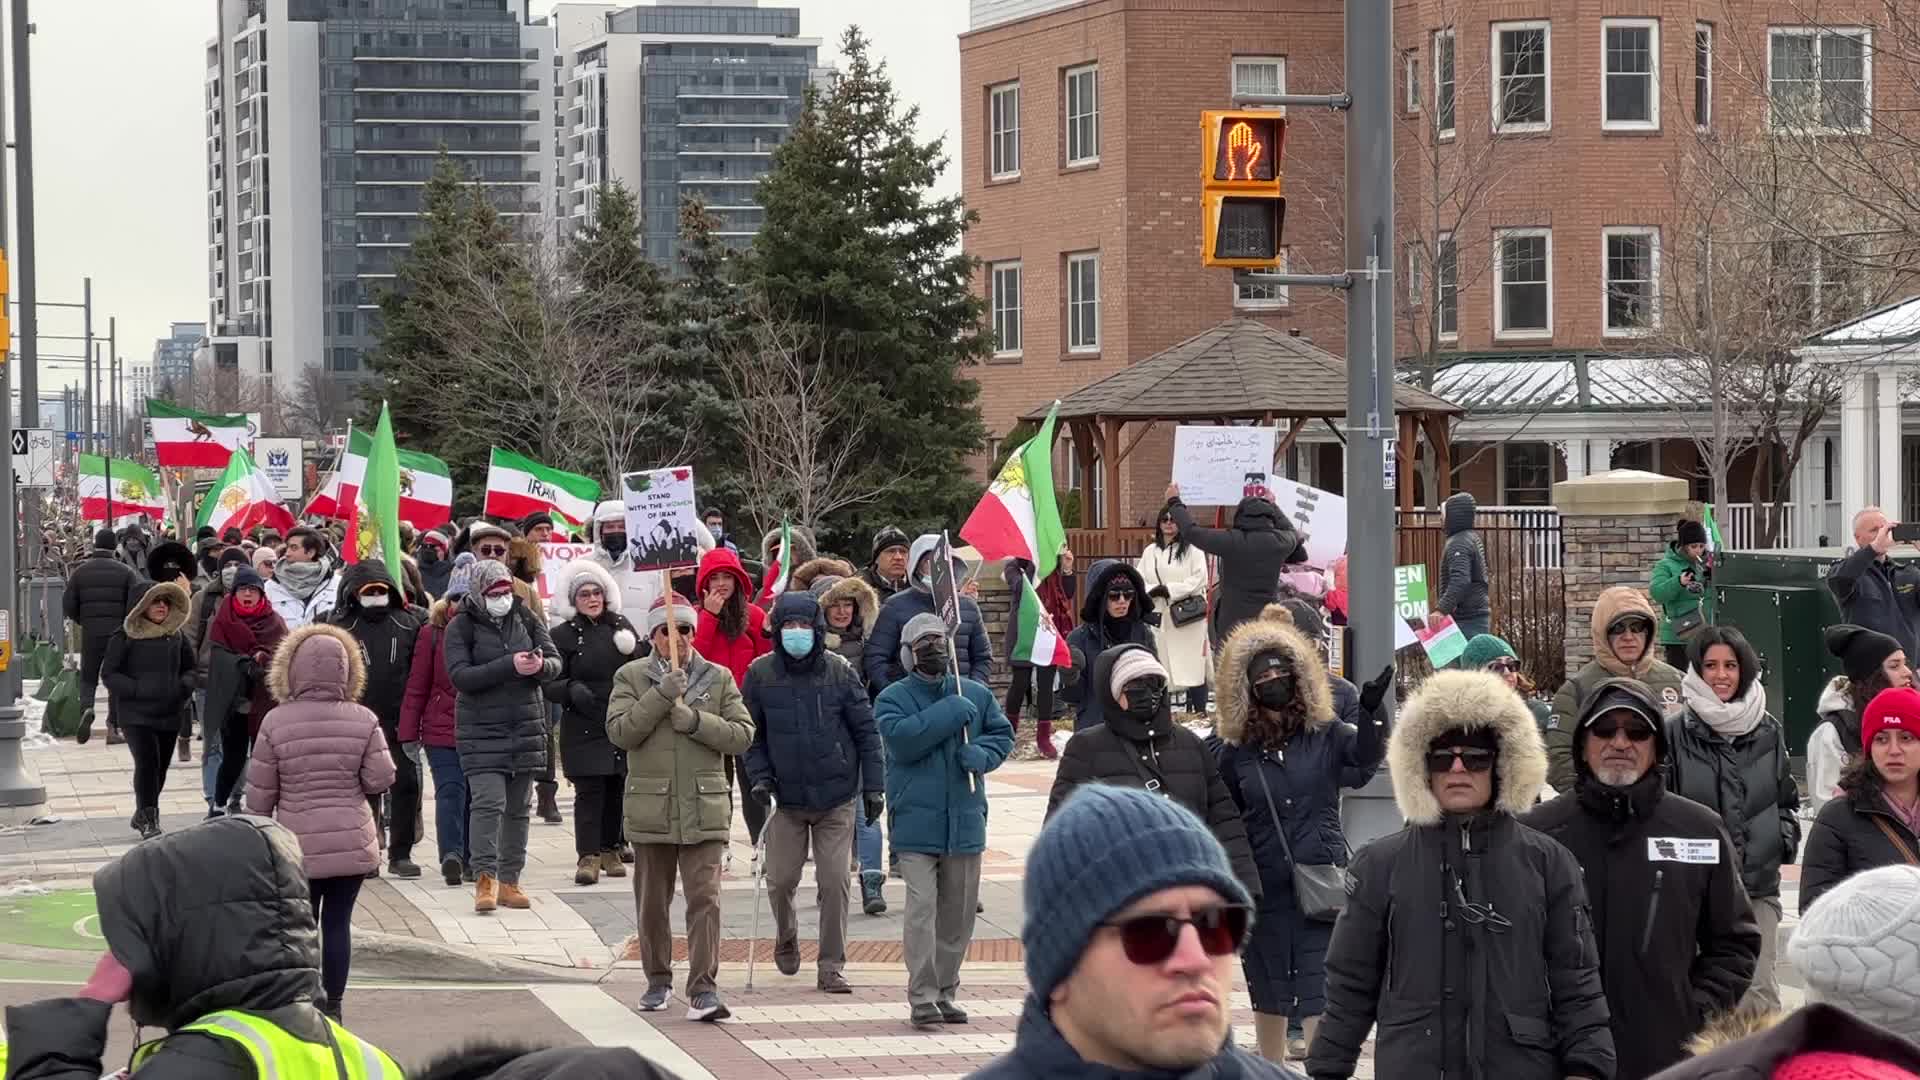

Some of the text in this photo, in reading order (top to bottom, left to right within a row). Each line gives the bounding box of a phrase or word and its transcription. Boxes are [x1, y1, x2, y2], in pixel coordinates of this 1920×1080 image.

[527, 478, 557, 502] IRAN
[1243, 485, 1266, 497] NO
[648, 492, 671, 500] STAND
[659, 510, 677, 518] IRAN
[1395, 566, 1422, 583] EN
[1883, 716, 1901, 724] FILA
